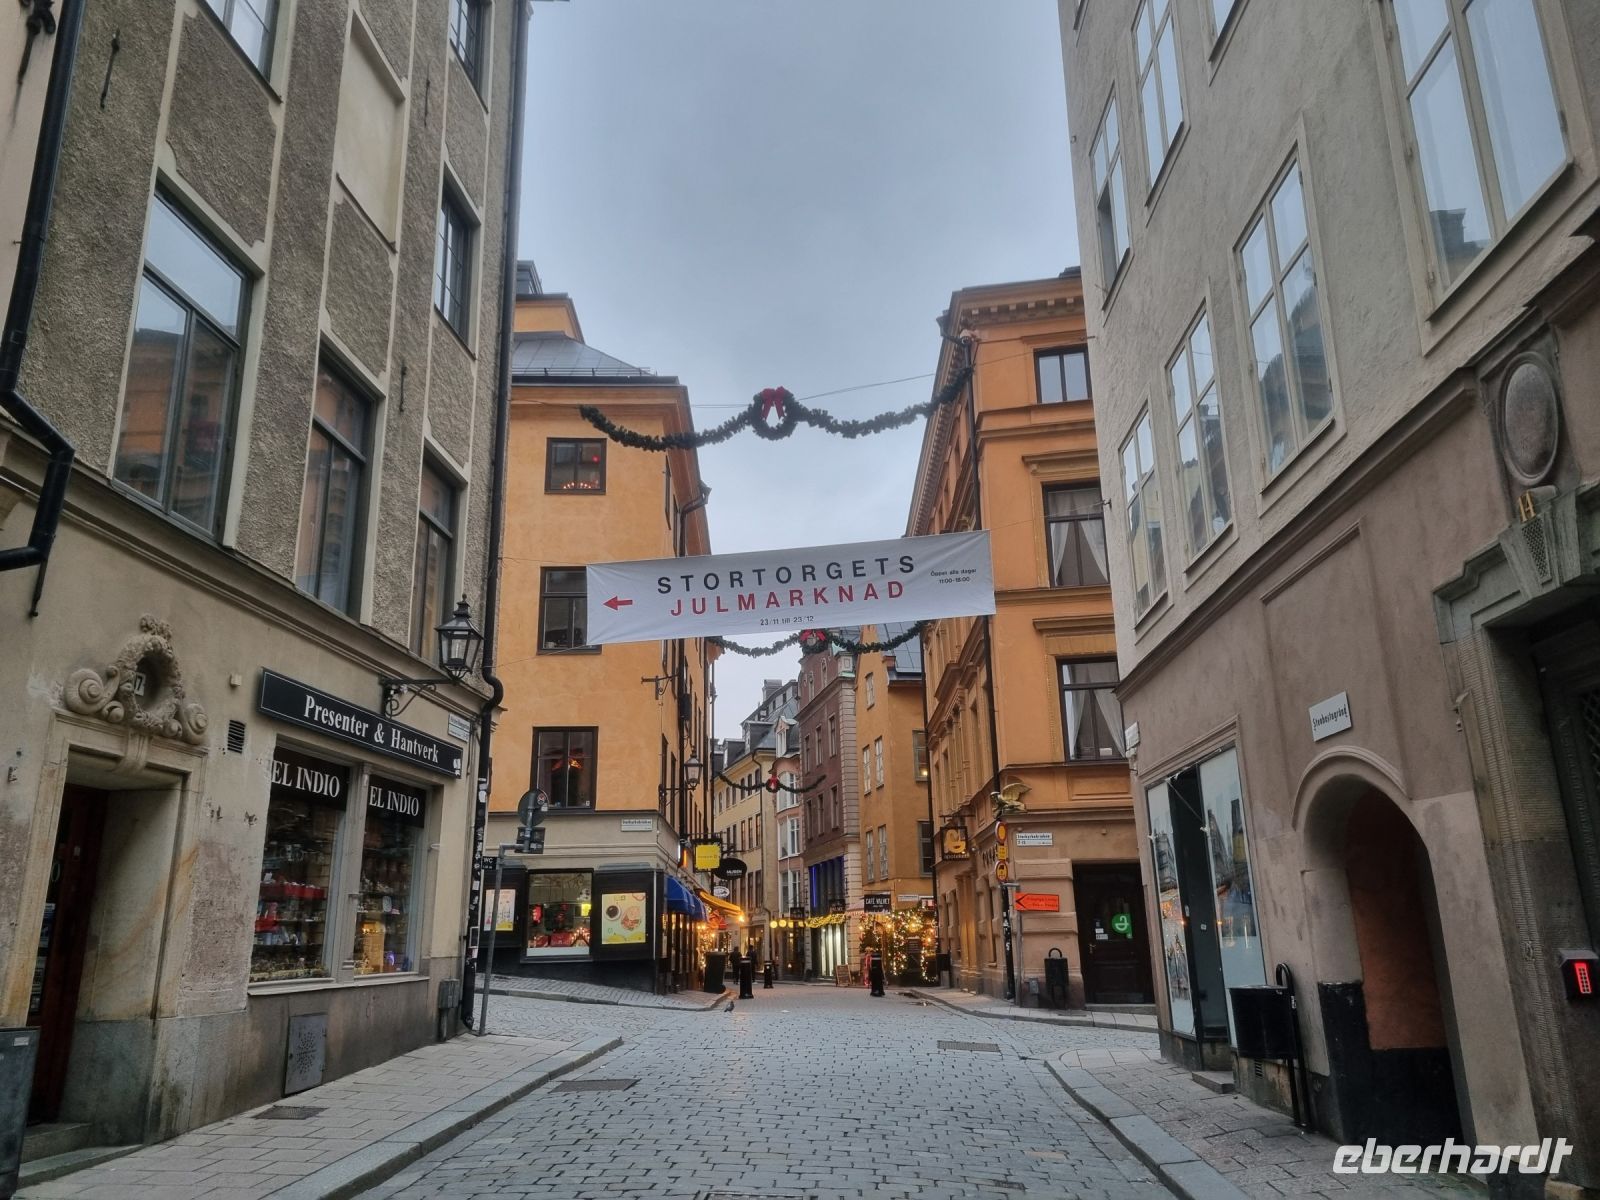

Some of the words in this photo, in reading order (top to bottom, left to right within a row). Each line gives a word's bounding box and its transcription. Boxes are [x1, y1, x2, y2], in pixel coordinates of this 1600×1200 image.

[1519, 490, 1537, 523] 14
[657, 555, 915, 594] STORTORGETS
[670, 580, 904, 617] JULMARKNAD
[137, 676, 143, 691] 7
[303, 694, 369, 739] Presenter
[373, 723, 386, 745] &
[391, 727, 439, 763] Hantverk
[271, 758, 292, 787] EL
[296, 766, 341, 798] INDIO
[369, 786, 384, 808] EL
[387, 789, 419, 816] INDIO
